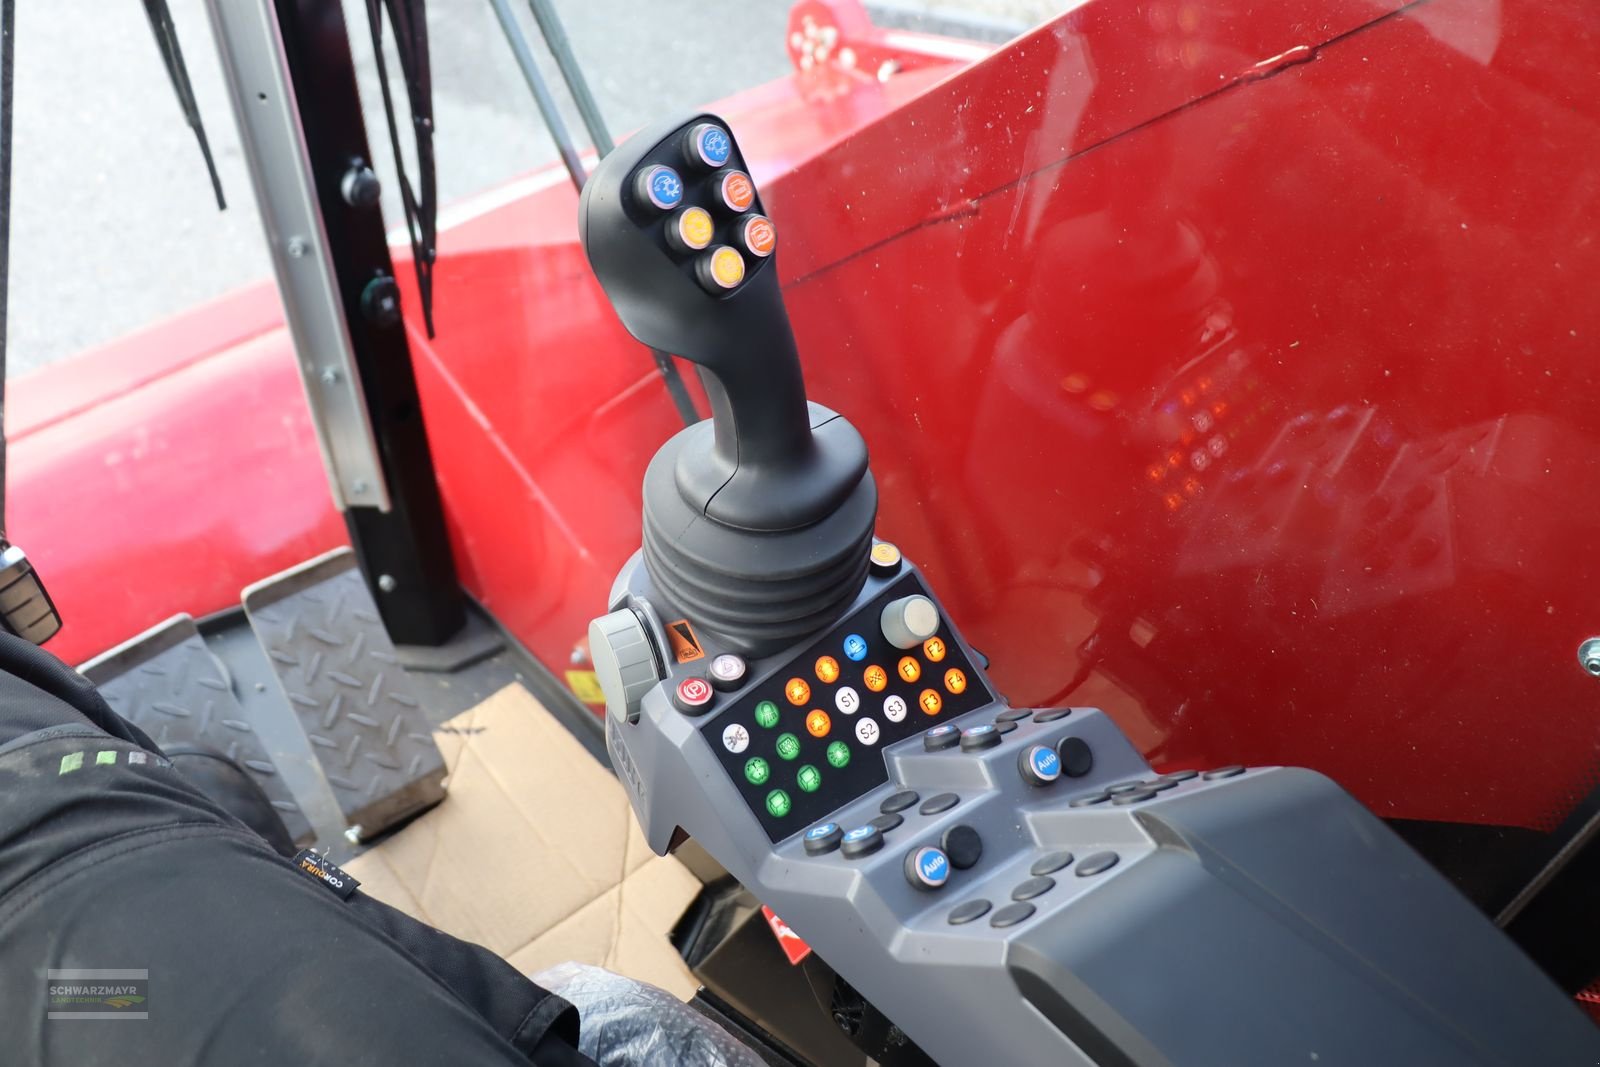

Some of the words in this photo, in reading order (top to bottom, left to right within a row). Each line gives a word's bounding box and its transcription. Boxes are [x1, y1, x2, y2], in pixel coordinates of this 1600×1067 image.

[927, 641, 943, 657] F2
[903, 662, 917, 677] F1
[948, 673, 964, 689] F4
[841, 692, 856, 708] S1
[888, 699, 904, 717] S3
[923, 694, 938, 710] F3
[860, 723, 876, 739] S2
[1038, 753, 1056, 771] Auto
[301, 860, 343, 888] CORDURA
[924, 856, 945, 876] Auto
